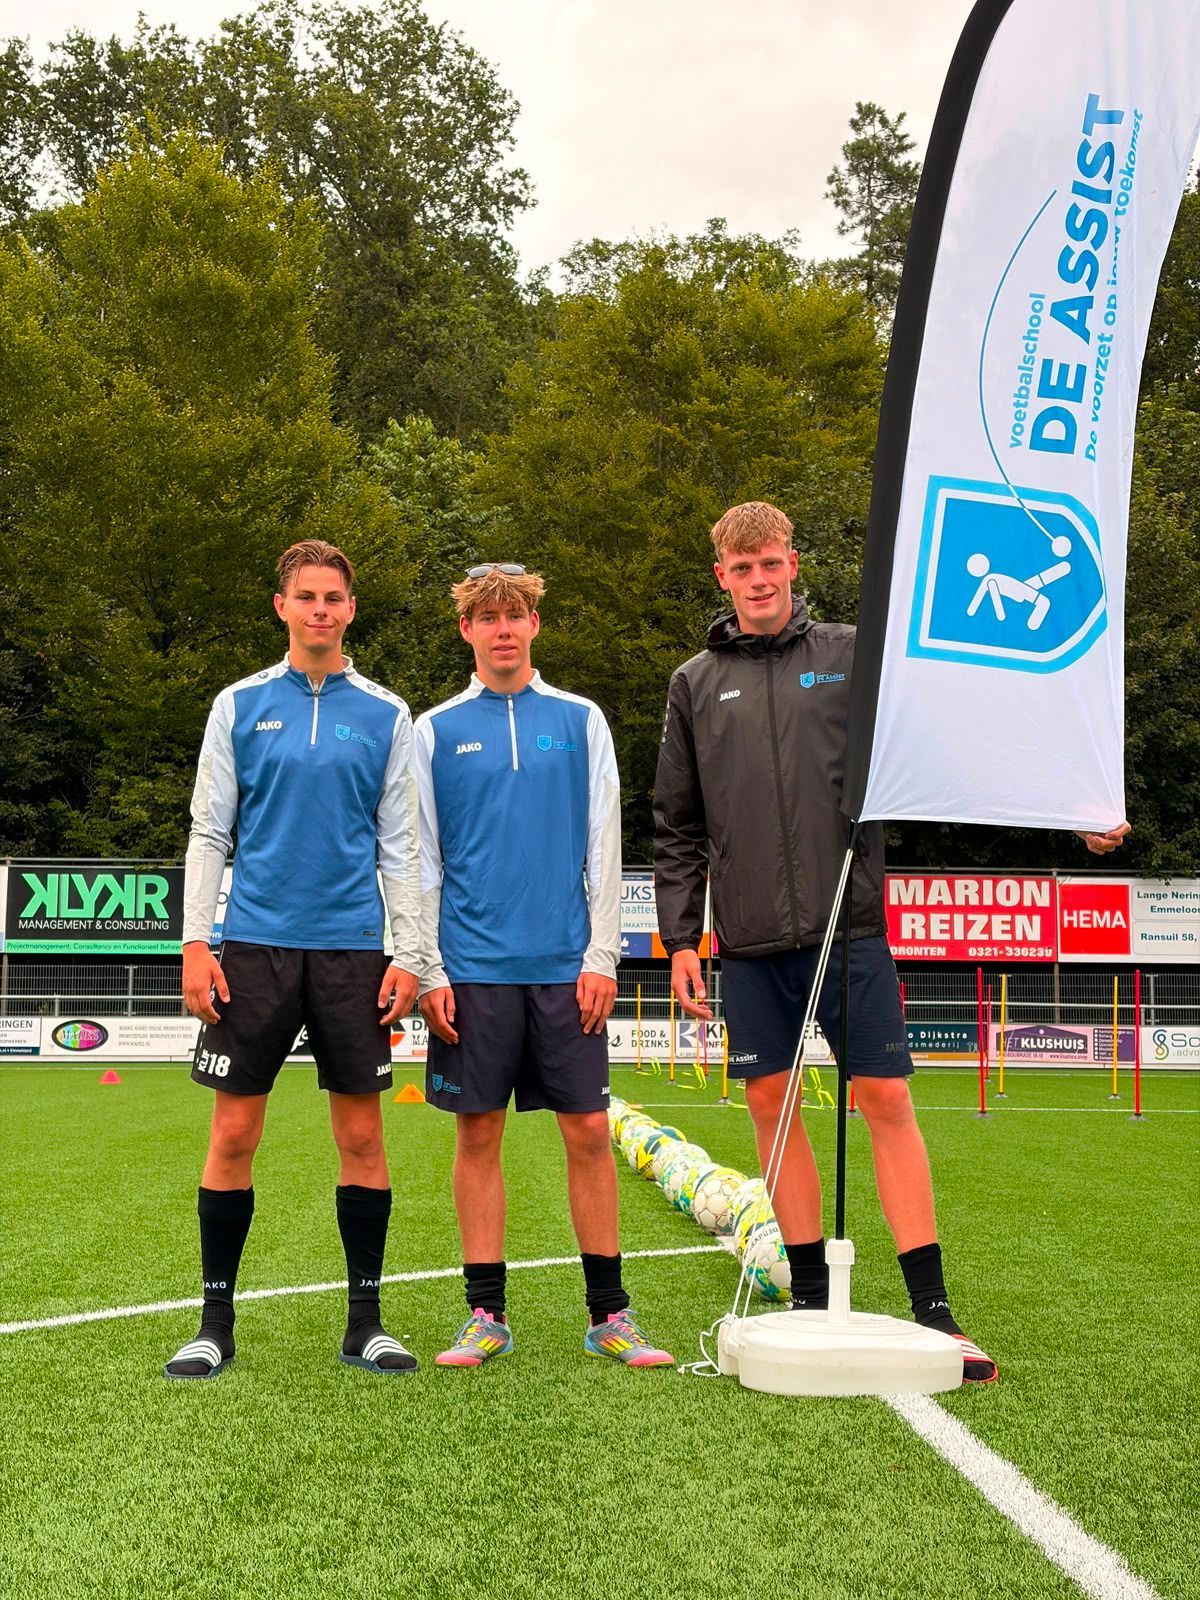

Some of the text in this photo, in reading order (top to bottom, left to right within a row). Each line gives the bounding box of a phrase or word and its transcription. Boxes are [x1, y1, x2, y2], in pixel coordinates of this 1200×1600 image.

[1029, 93, 1125, 455] DE ASSIST
[1084, 430, 1098, 463] De
[1091, 332, 1114, 423] voorzet
[1103, 294, 1118, 326] op
[1114, 109, 1144, 217] toekomst
[1009, 293, 1046, 448] voetbalschool
[719, 690, 741, 701] JAKO
[255, 720, 283, 732] JAKO
[455, 742, 483, 755] JAKO
[888, 879, 1051, 908] MARION
[1136, 890, 1200, 901] Lange Nerin
[18, 919, 170, 931] MANAGEMENT & CONSULTING
[1063, 910, 1127, 929] HEMA
[900, 913, 1041, 941] REIZEN
[1140, 932, 1198, 943] Ransuil 58,
[123, 943, 159, 951] Functioneel
[891, 946, 946, 957] DRONTEN
[0, 1019, 33, 1029] INGEN
[631, 1029, 667, 1039] FOOD &
[919, 1031, 968, 1040] Dijkstra
[631, 1039, 671, 1049] DRINKS
[1020, 1037, 1085, 1050] KLUSHUIS
[208, 1053, 231, 1077] 18
